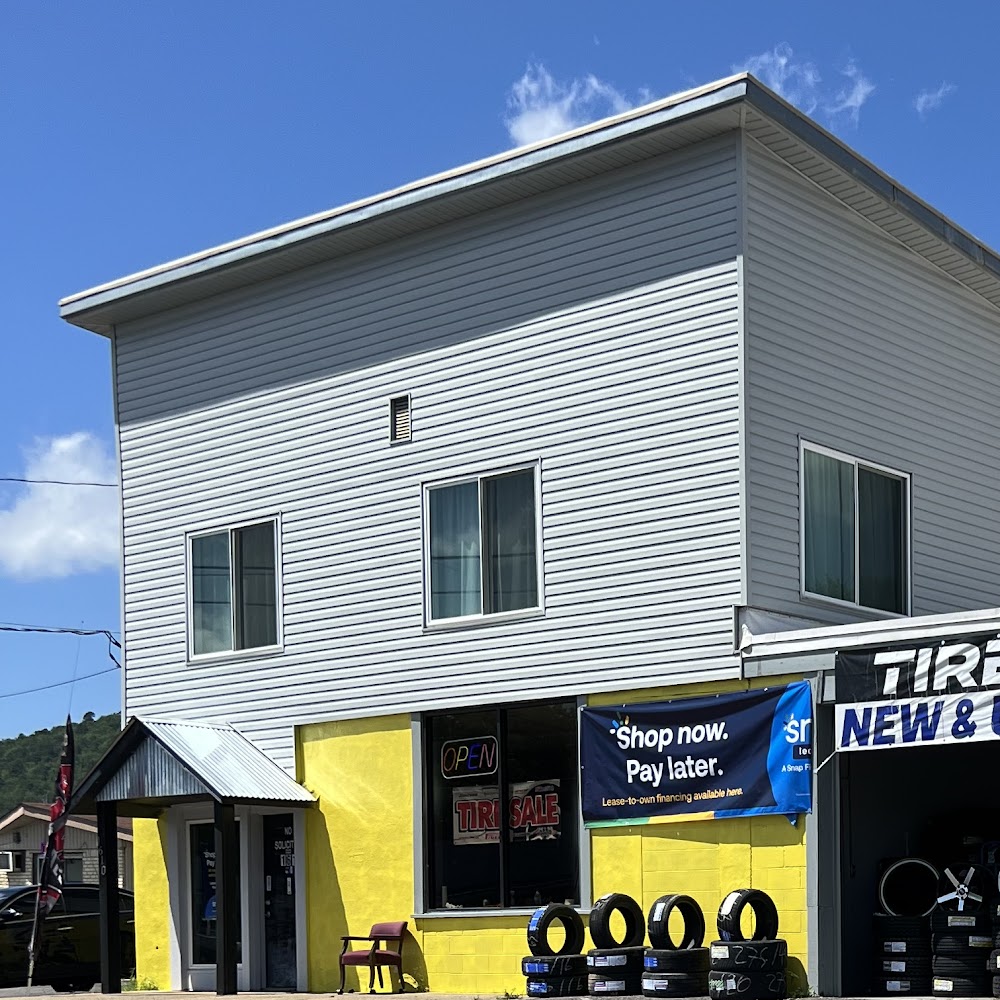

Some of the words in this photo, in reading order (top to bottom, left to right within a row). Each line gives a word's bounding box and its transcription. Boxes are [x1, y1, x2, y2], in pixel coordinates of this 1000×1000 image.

[616, 724, 674, 752] Shop
[677, 722, 729, 744] now.
[841, 700, 944, 747] NEW
[951, 699, 977, 739] &
[443, 743, 495, 771] OPEN
[626, 759, 664, 788] Pay
[668, 755, 724, 781] later.
[787, 764, 804, 773] Snap
[509, 793, 560, 828] SALE
[602, 796, 656, 807] Lease-to-own
[656, 792, 692, 803] financing
[693, 789, 725, 801] available
[726, 788, 744, 798] here.
